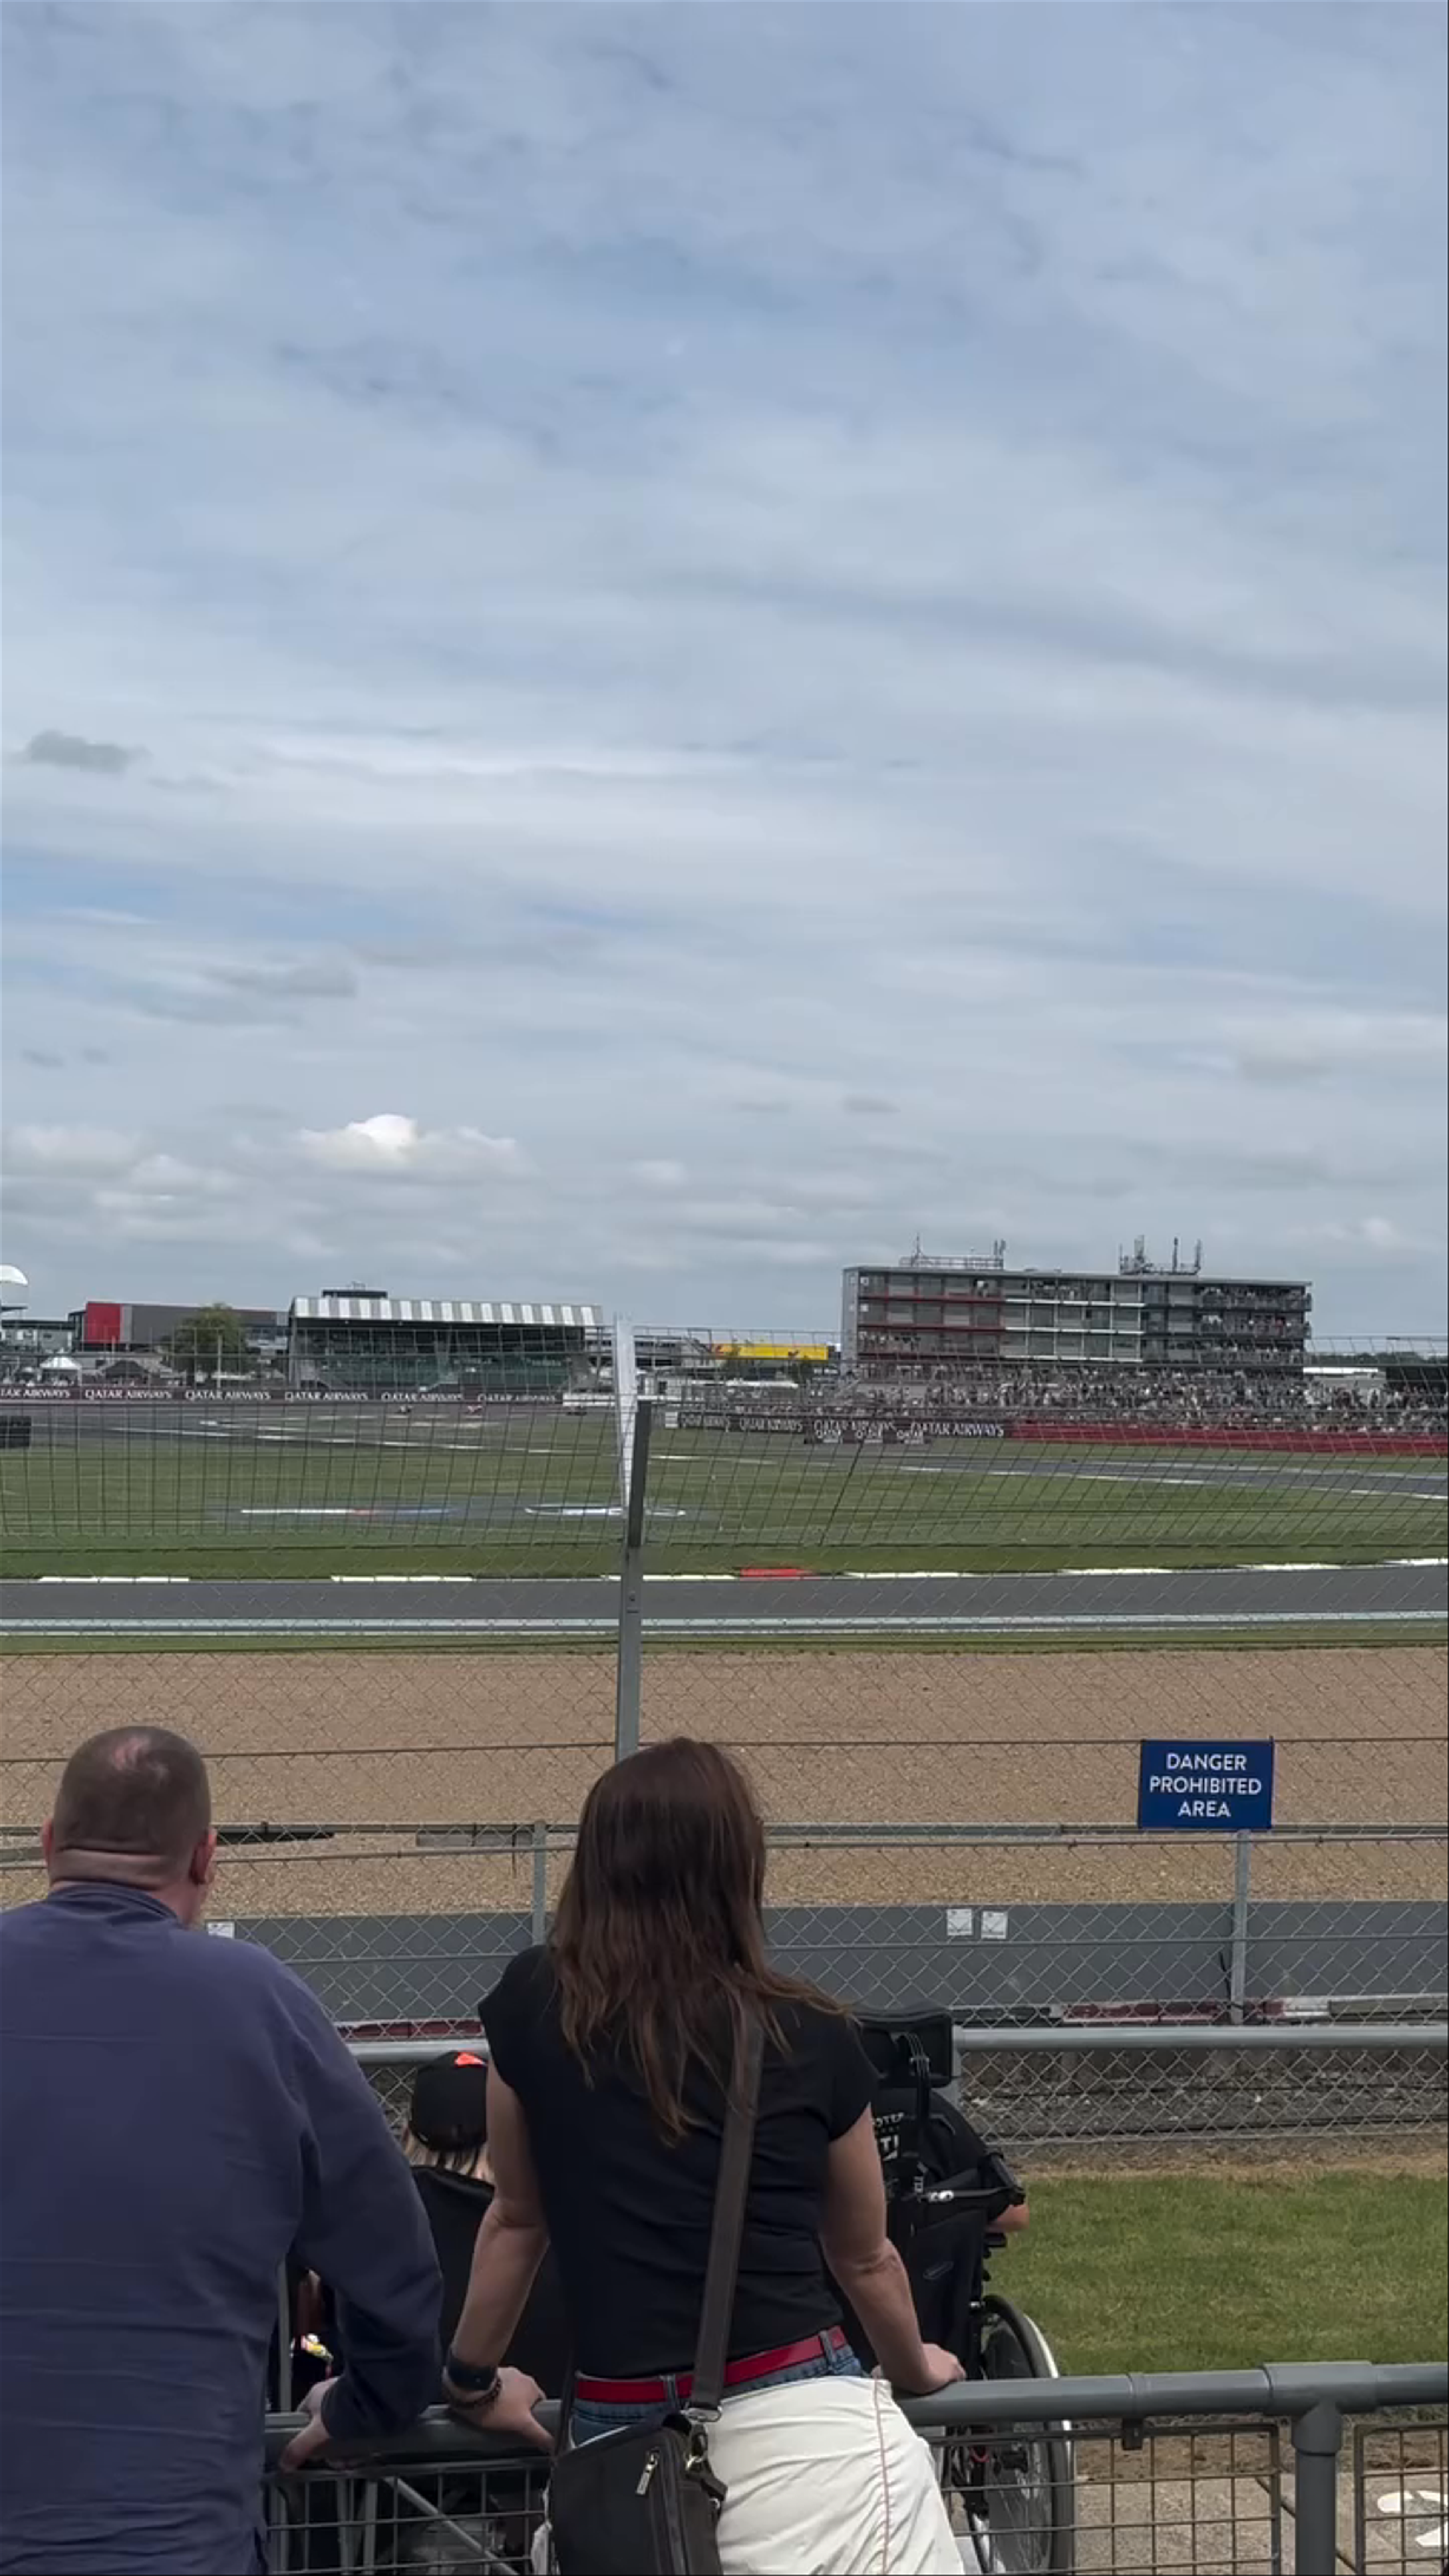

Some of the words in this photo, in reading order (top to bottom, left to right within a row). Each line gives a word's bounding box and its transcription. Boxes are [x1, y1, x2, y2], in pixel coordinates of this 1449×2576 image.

[85, 1389, 122, 1400] QATAR
[127, 1389, 172, 1398] AIRWAYS
[185, 1390, 223, 1401] QATAR
[225, 1391, 271, 1400] AIRWAYS
[285, 1391, 321, 1402] QATAR
[323, 1392, 368, 1401] AIRWAYS
[381, 1392, 417, 1403] QATAR
[953, 1423, 1004, 1437] AIRWAYS
[1166, 1753, 1247, 1771] DANGER
[1149, 1776, 1262, 1795] PROHIBITED
[1178, 1800, 1231, 1817] AREA
